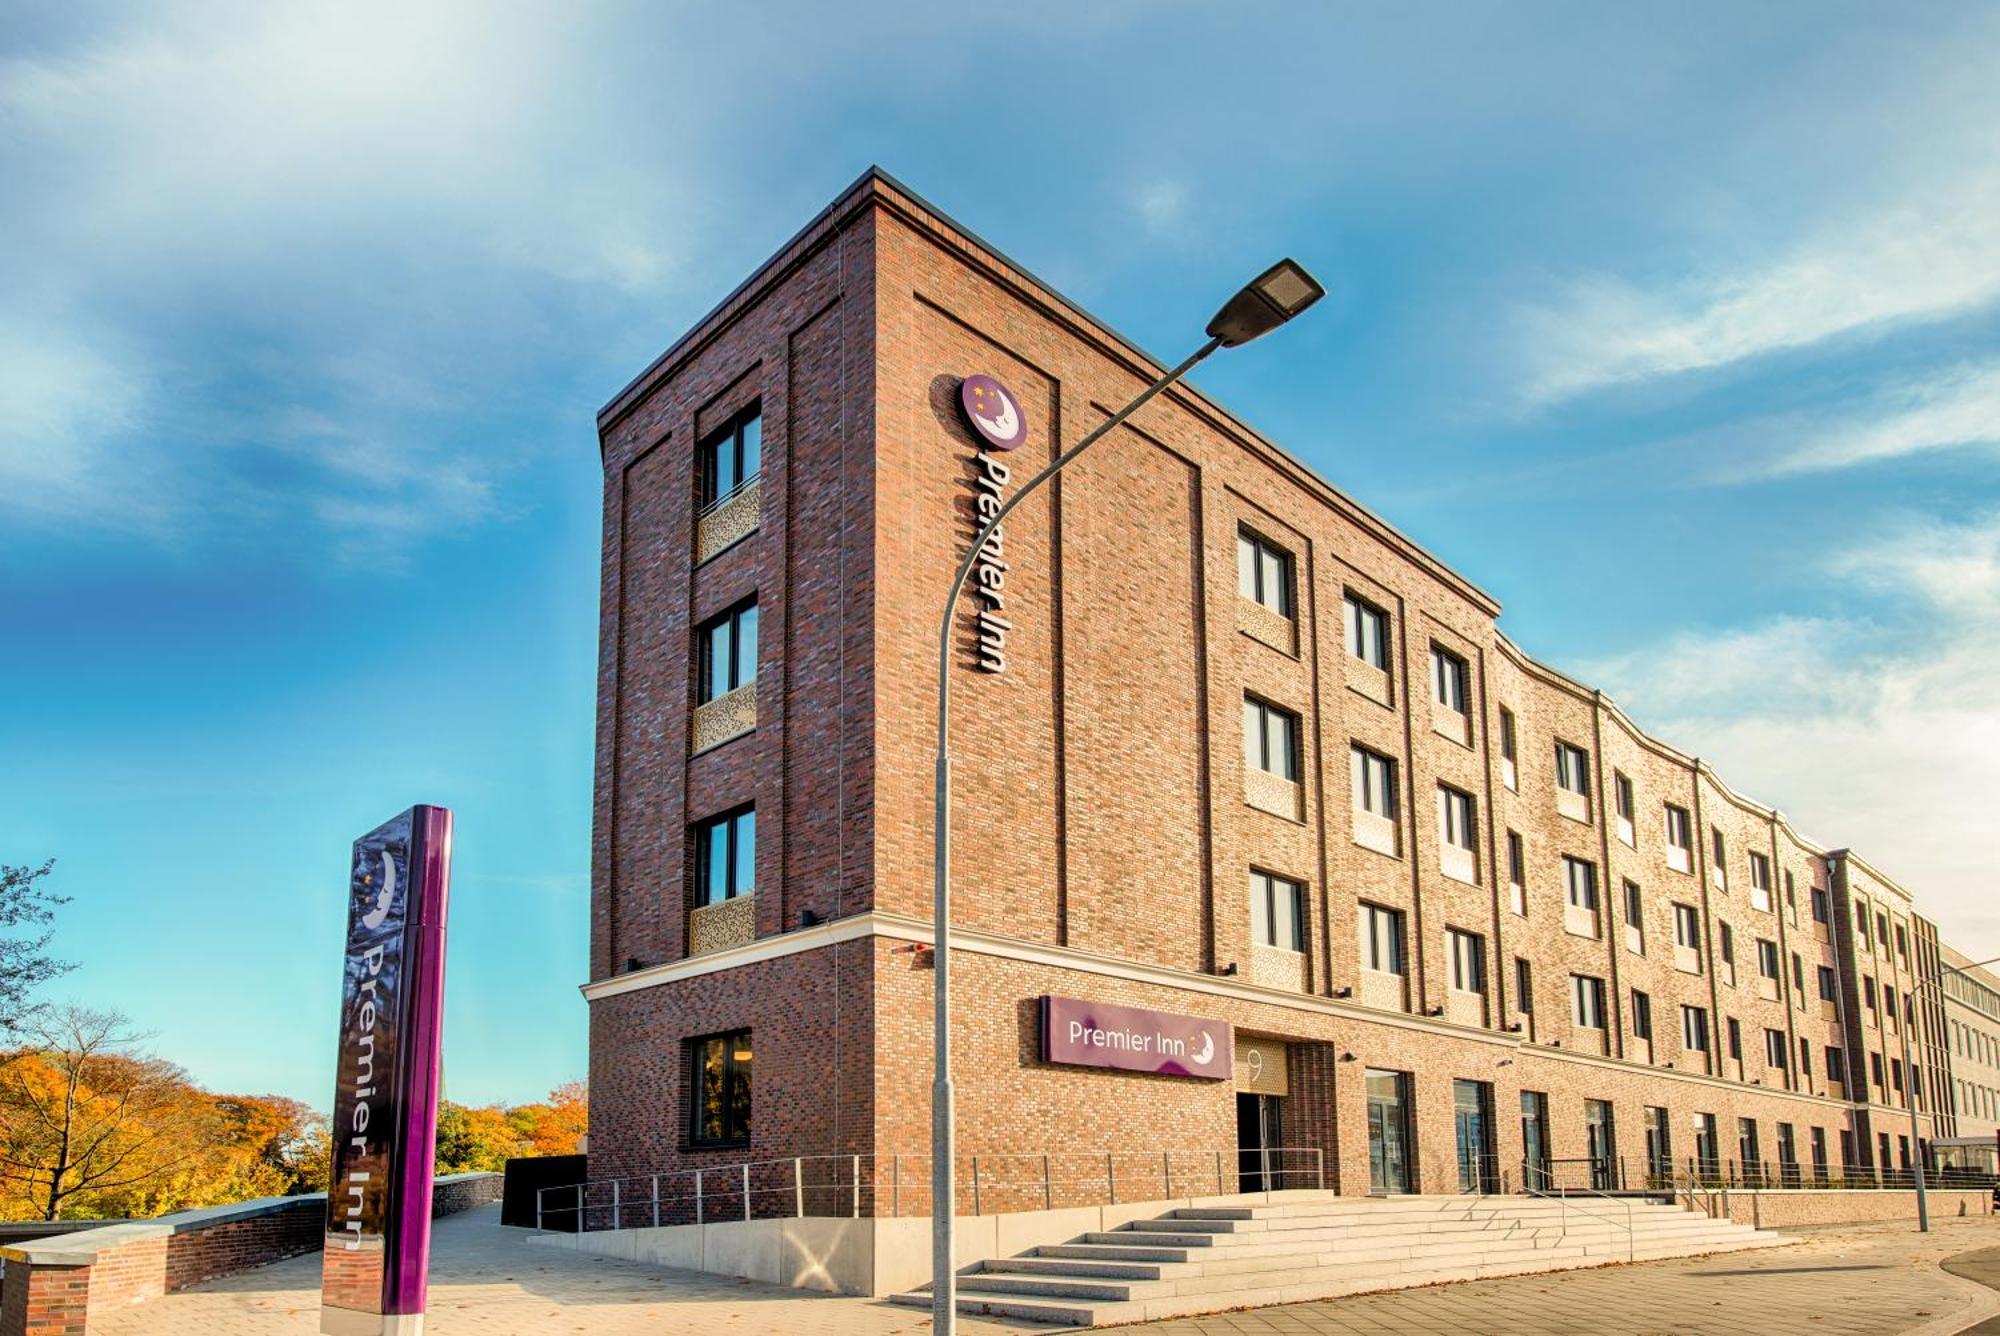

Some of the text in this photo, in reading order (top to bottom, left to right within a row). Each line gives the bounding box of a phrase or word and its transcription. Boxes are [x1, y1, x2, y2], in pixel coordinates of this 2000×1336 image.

[980, 610, 1012, 673] Inn
[1069, 1021, 1185, 1057] Premier Inn
[1247, 1049, 1262, 1082] 9
[344, 944, 384, 1252] Premier Inn
